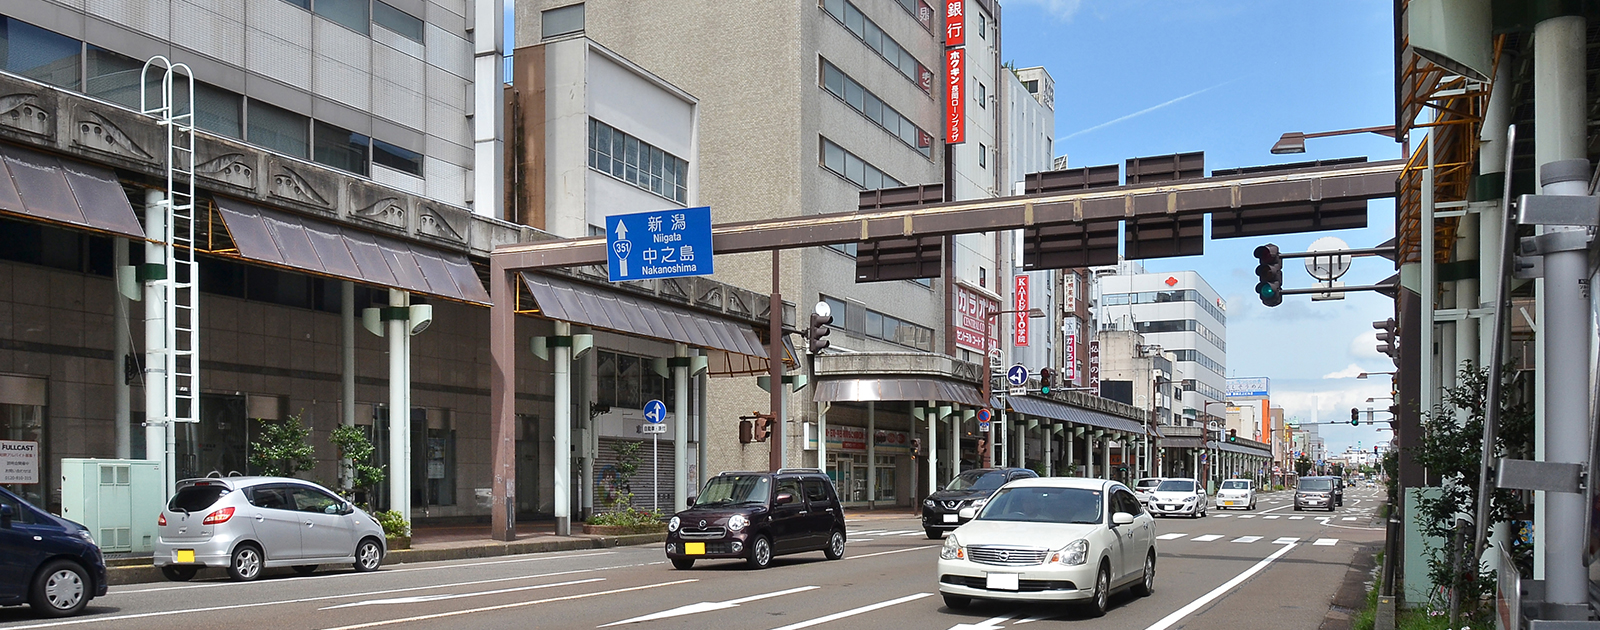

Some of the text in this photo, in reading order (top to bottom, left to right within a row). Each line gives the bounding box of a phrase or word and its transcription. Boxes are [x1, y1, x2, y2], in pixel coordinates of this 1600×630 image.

[947, 2, 962, 38] 銀行
[647, 213, 686, 232] 新潟
[653, 233, 682, 243] Niigata
[616, 243, 629, 253] 351
[642, 244, 695, 264] 中之島
[642, 263, 697, 275] Nakanoshima
[959, 288, 997, 322] カラオケ
